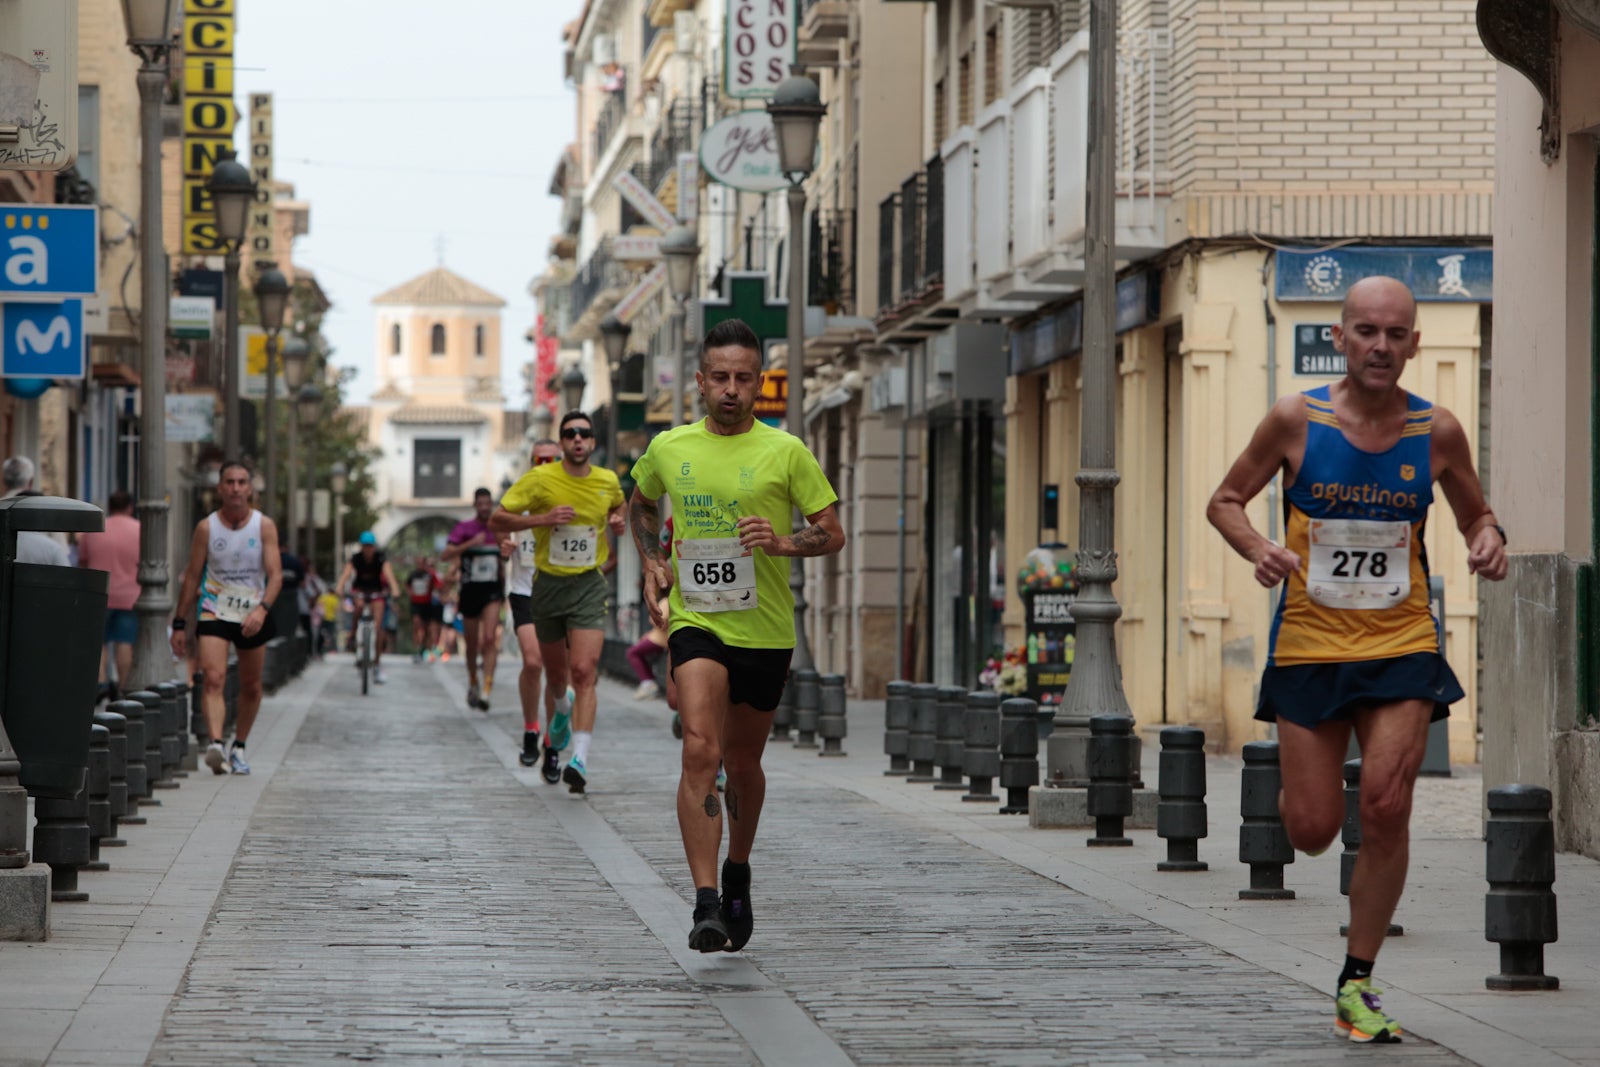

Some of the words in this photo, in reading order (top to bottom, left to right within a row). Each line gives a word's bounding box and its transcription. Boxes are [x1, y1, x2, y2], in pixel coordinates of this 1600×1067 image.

[736, 0, 755, 85] COS
[253, 96, 269, 269] PIONONO
[682, 494, 713, 507] XXVIII
[1311, 482, 1418, 509] agustinos
[684, 509, 710, 518] Prueba
[561, 539, 588, 552] 126
[693, 562, 736, 585] 658
[1332, 550, 1388, 578] 278
[227, 596, 250, 609] 714
